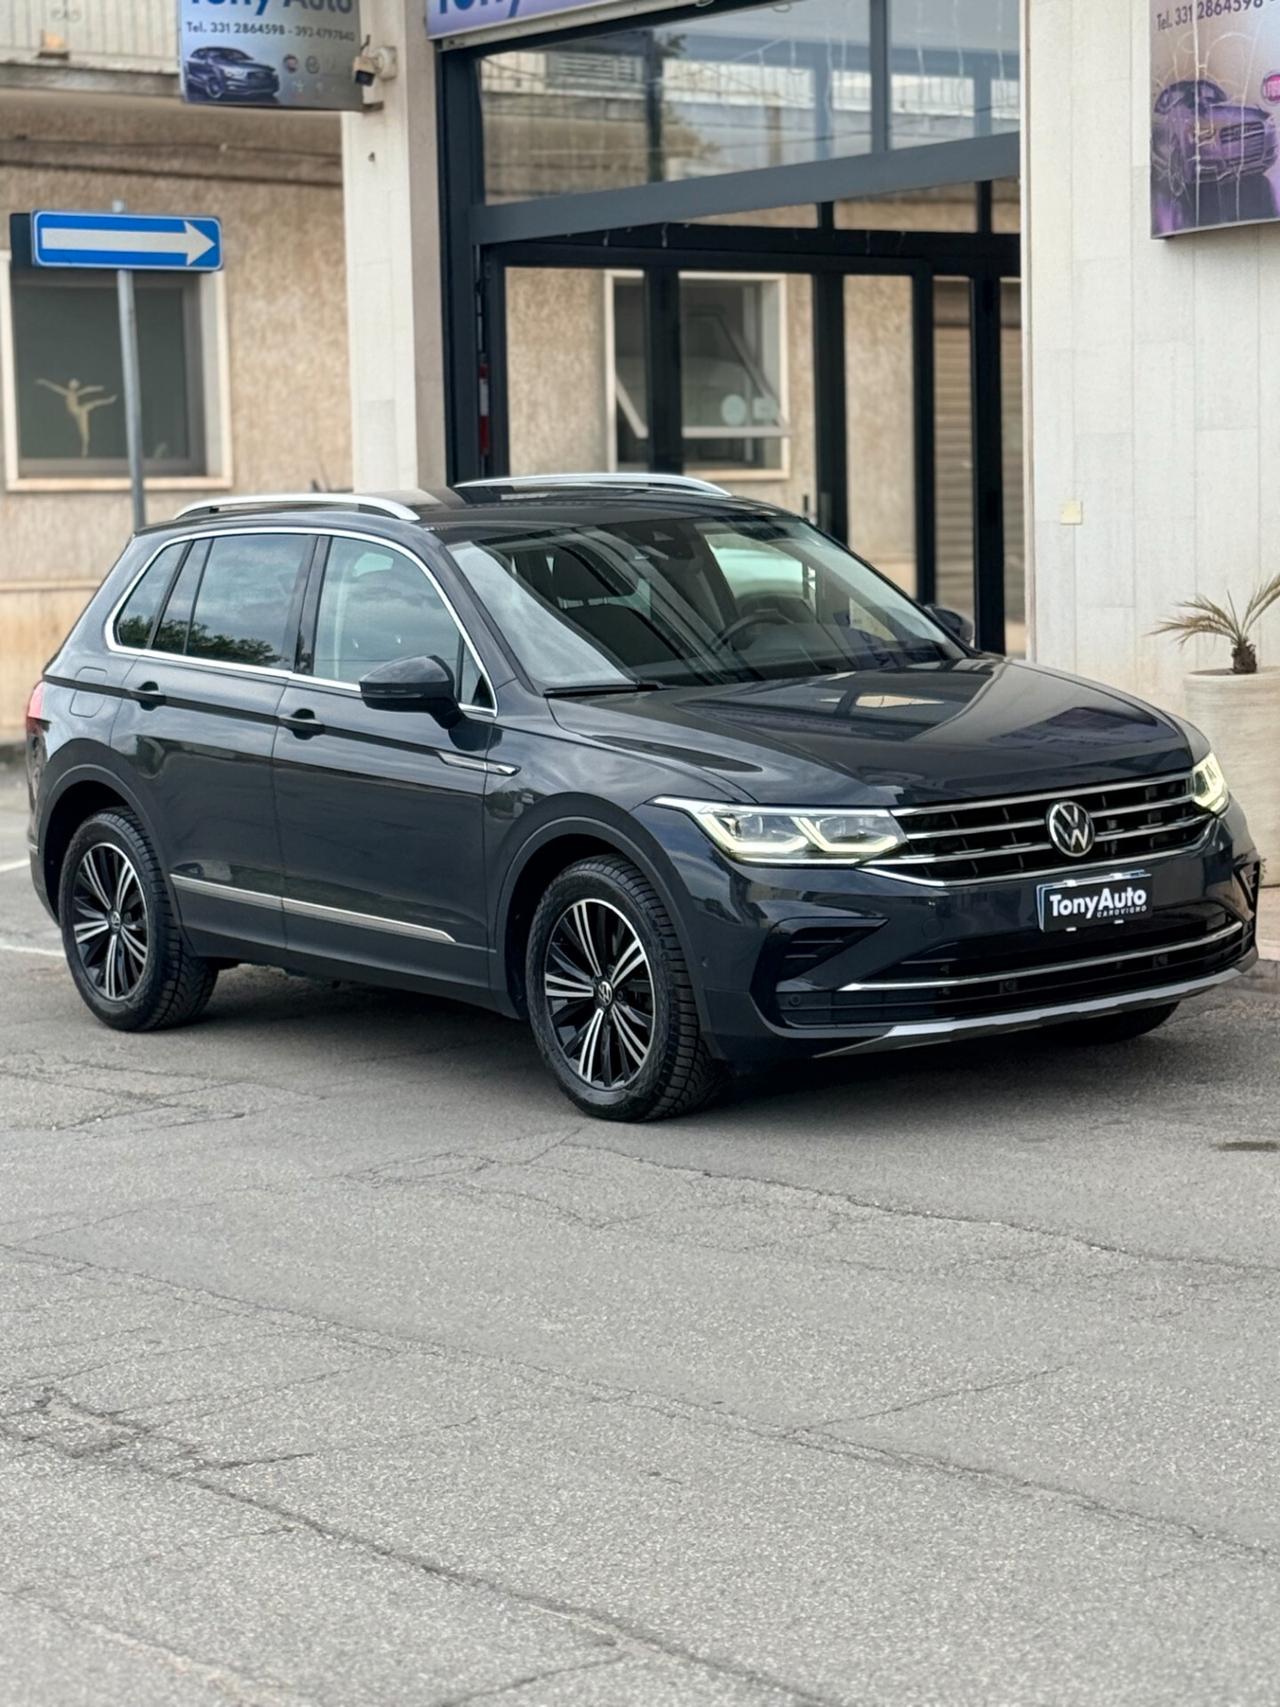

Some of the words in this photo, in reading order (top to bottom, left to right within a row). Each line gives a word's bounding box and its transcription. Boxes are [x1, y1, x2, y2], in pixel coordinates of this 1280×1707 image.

[187, 21, 208, 33] Tel.
[210, 22, 231, 34] 331
[233, 22, 285, 36] 2864598
